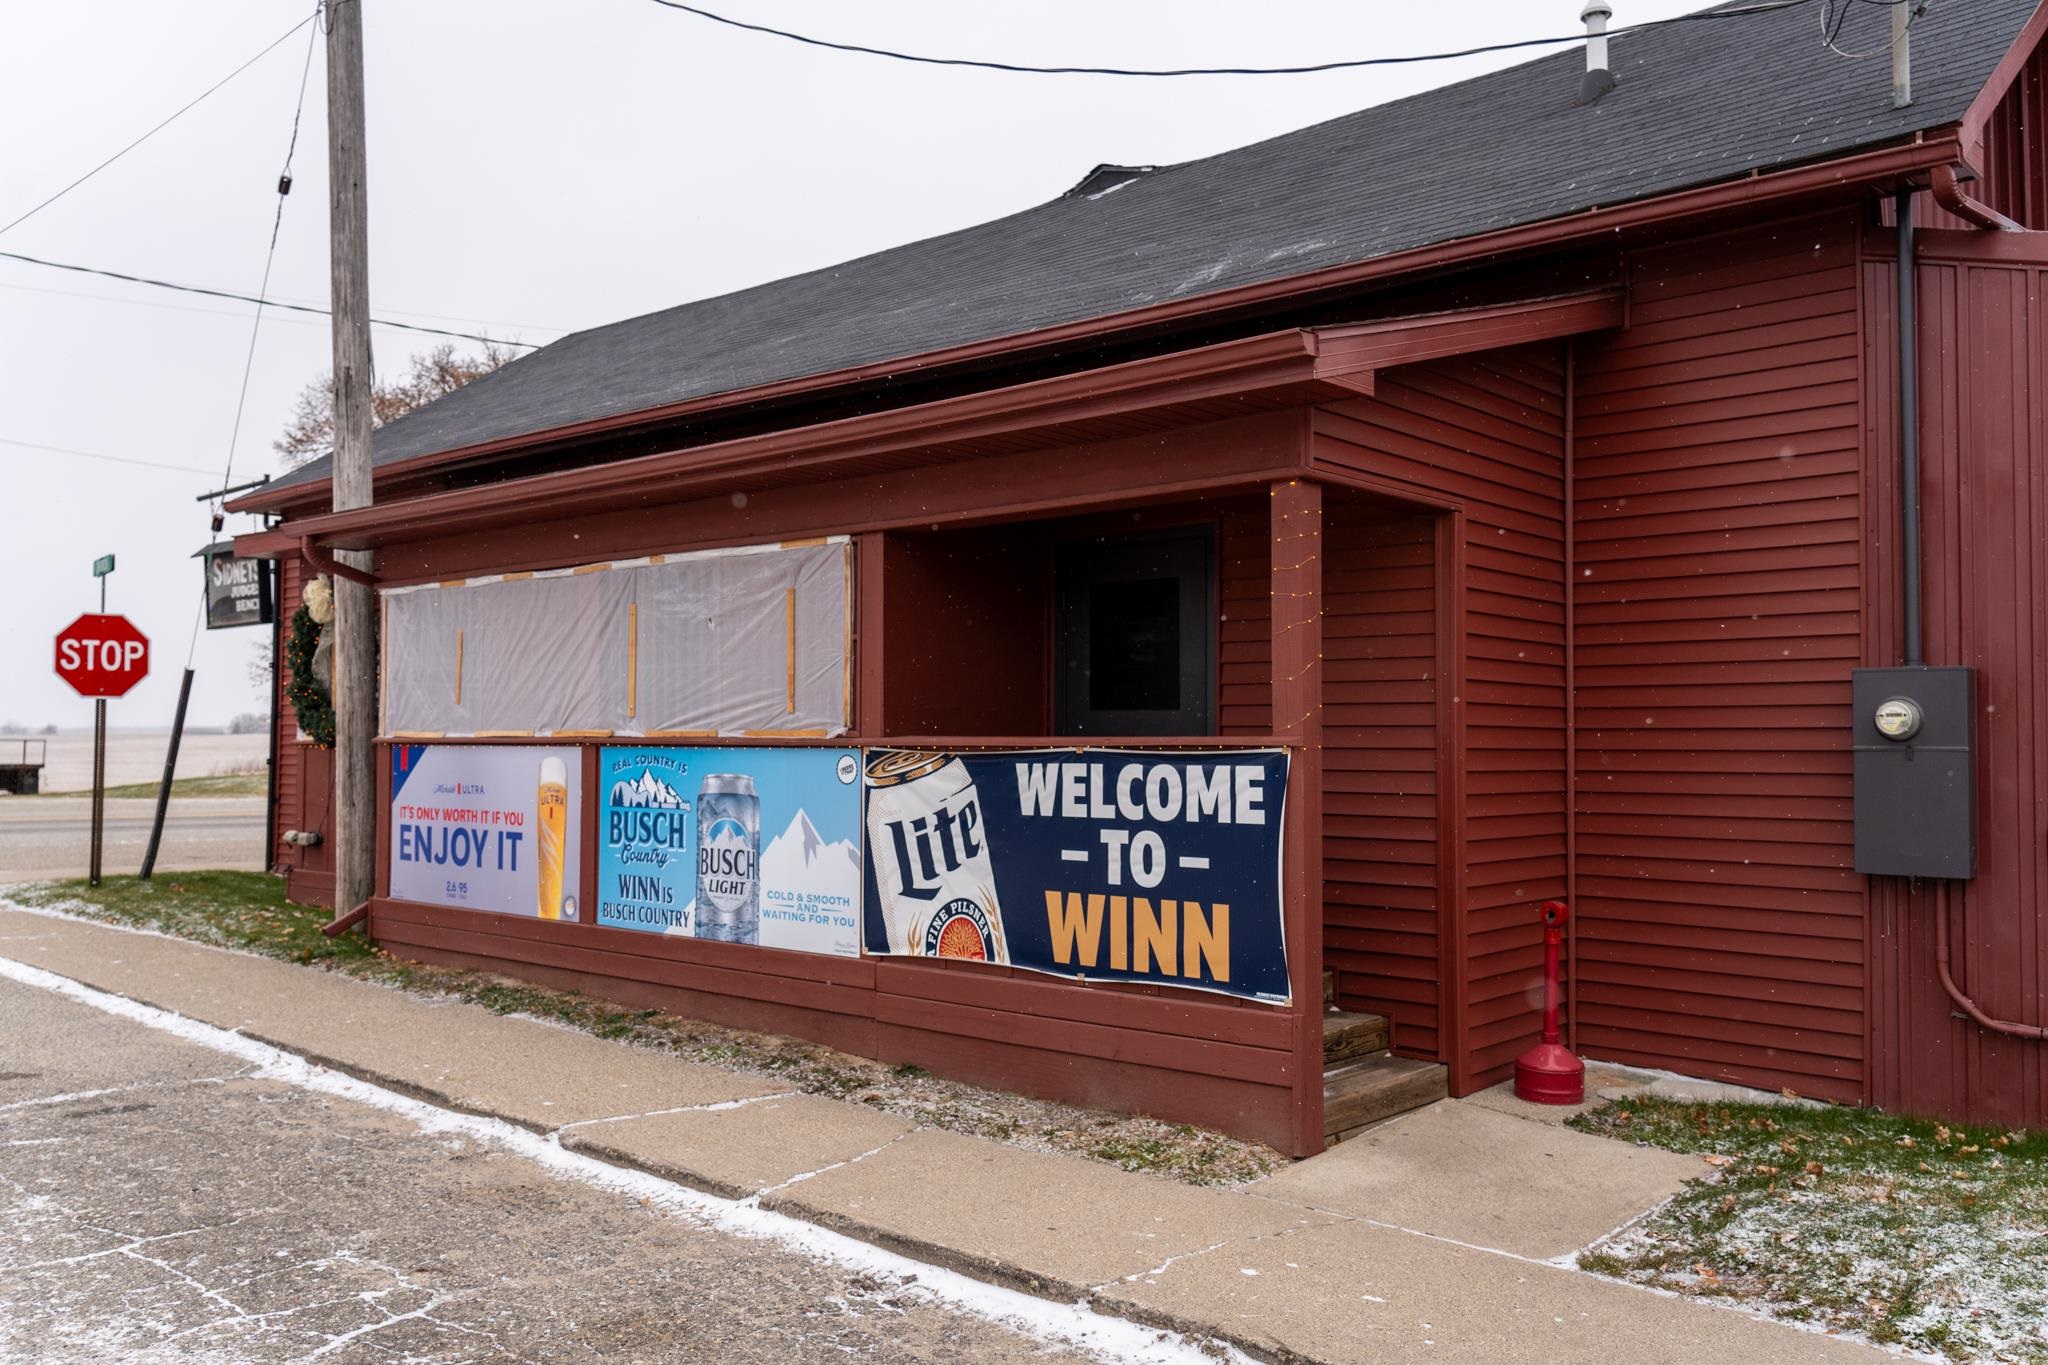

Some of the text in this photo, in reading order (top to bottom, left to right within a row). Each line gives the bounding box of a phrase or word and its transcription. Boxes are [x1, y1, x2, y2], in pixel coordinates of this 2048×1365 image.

[60, 638, 144, 672] STOP
[612, 755, 688, 775] REAL COUNTRY IS
[462, 784, 485, 795] ULTRA
[541, 794, 564, 806] ULTRA
[1015, 763, 1266, 825] WELCOME
[400, 805, 524, 826] IT'S ONLY WORTH IT IF YOU
[610, 810, 685, 849] BUSCH
[400, 824, 523, 871] ENJOY IT
[622, 843, 669, 868] Country
[884, 800, 981, 901] Lite
[1100, 829, 1166, 888] TO
[701, 848, 755, 880] BUSCH
[459, 882, 468, 893] 95
[618, 874, 673, 904] WINN IS
[709, 879, 746, 895] LIGHT
[767, 890, 850, 906] COLD & SMOOTH
[603, 902, 690, 927] BUSCH COUNTRY
[763, 909, 855, 927] WAITING FOR YOU
[797, 903, 818, 913] AND
[928, 909, 949, 944] FINE
[950, 901, 989, 938] PILSNER
[1045, 890, 1230, 983] WINN
